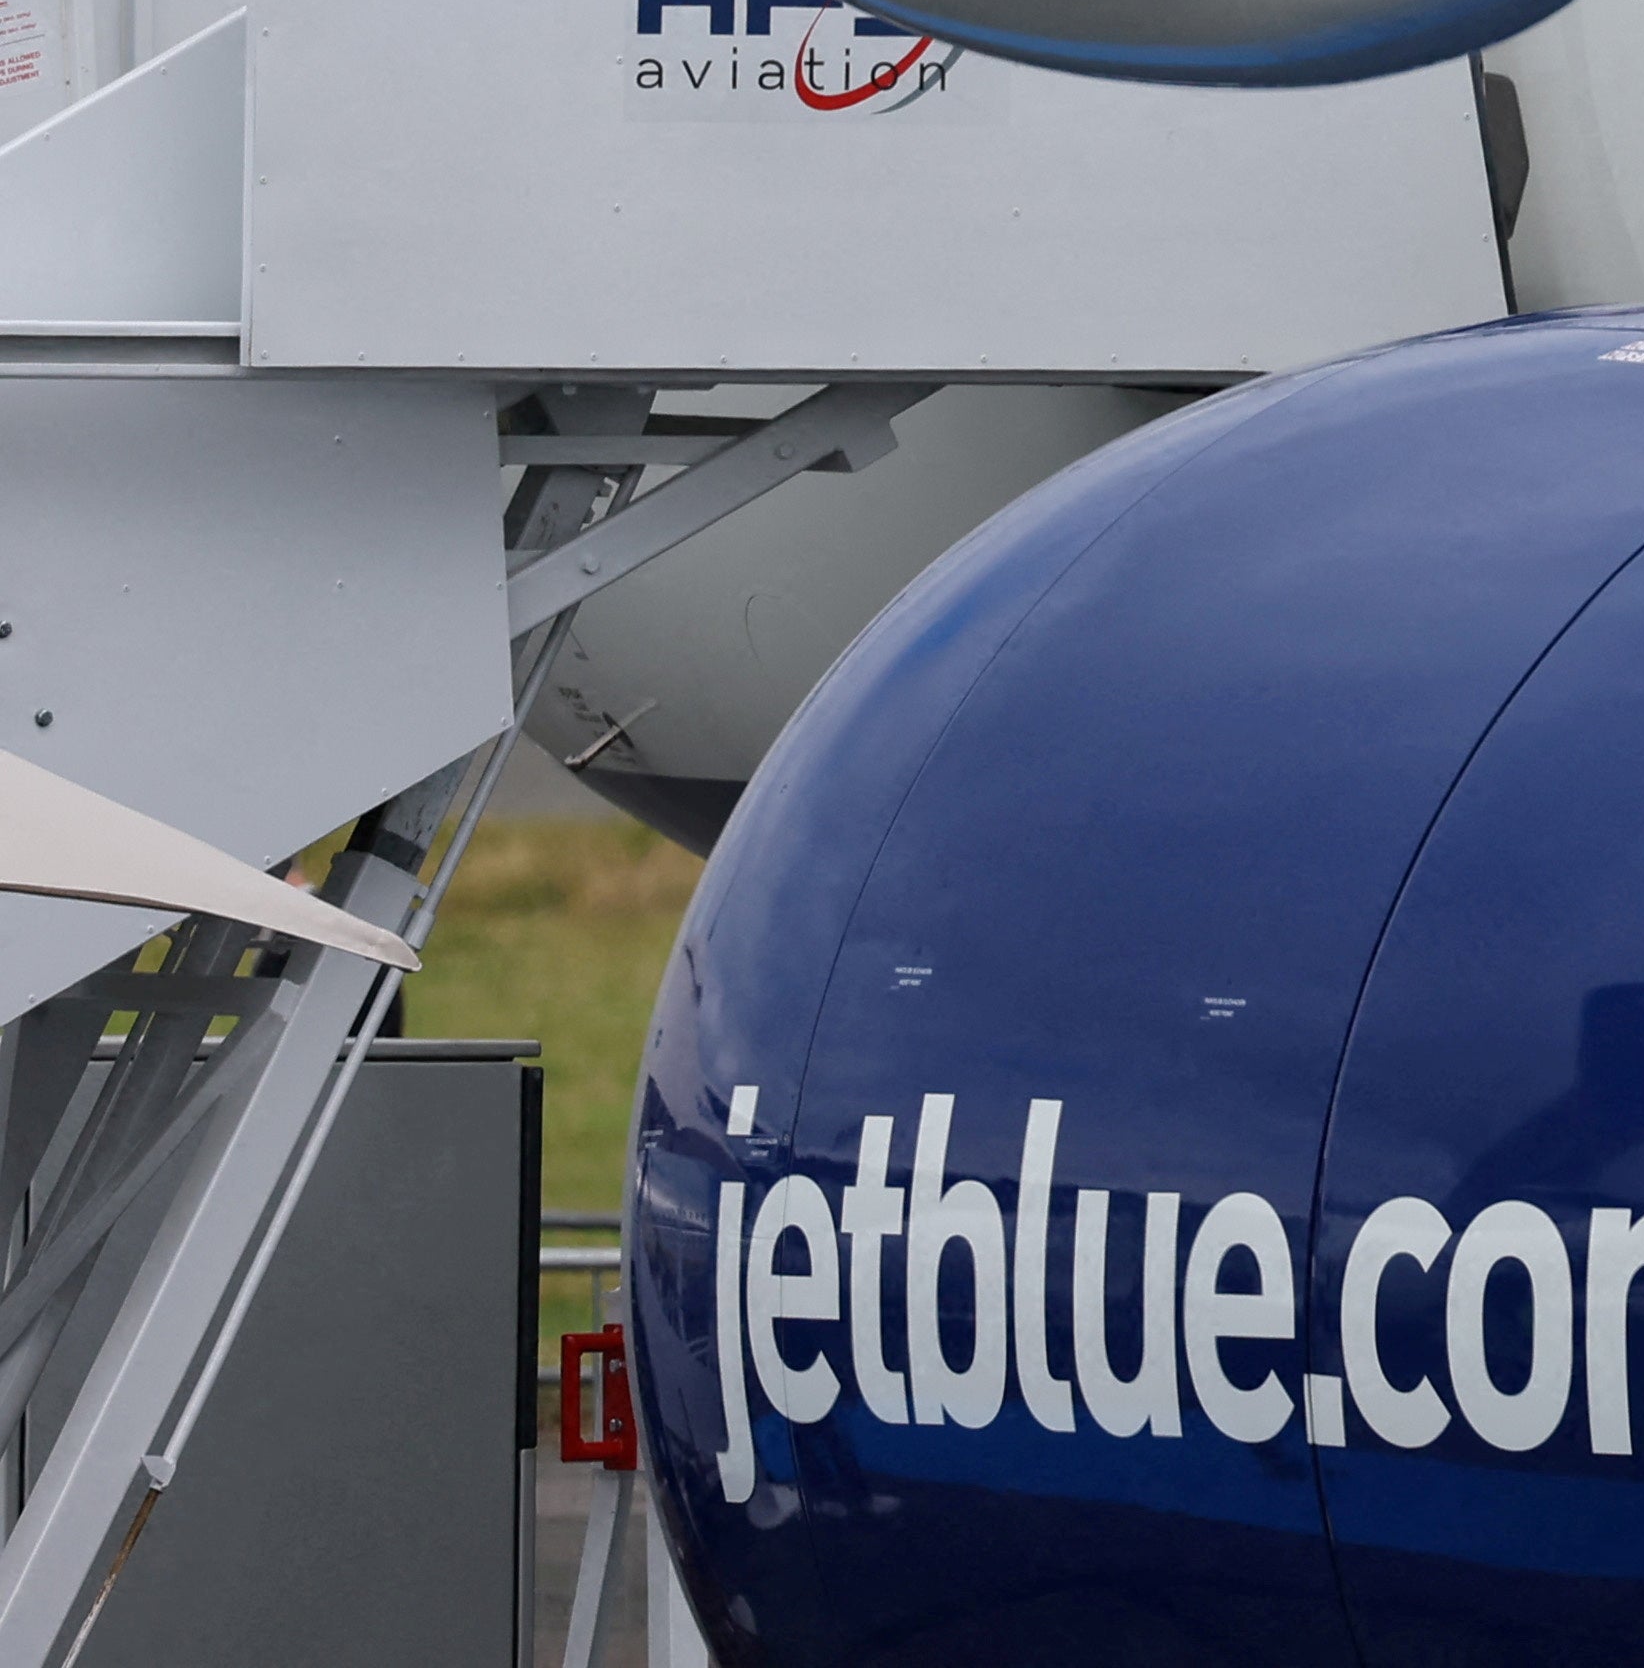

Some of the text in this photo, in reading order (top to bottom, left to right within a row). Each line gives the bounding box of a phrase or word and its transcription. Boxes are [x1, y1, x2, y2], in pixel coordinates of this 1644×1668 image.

[8, 51, 41, 64] ALLOWED
[7, 63, 34, 74] DURING
[636, 46, 947, 91] aviation
